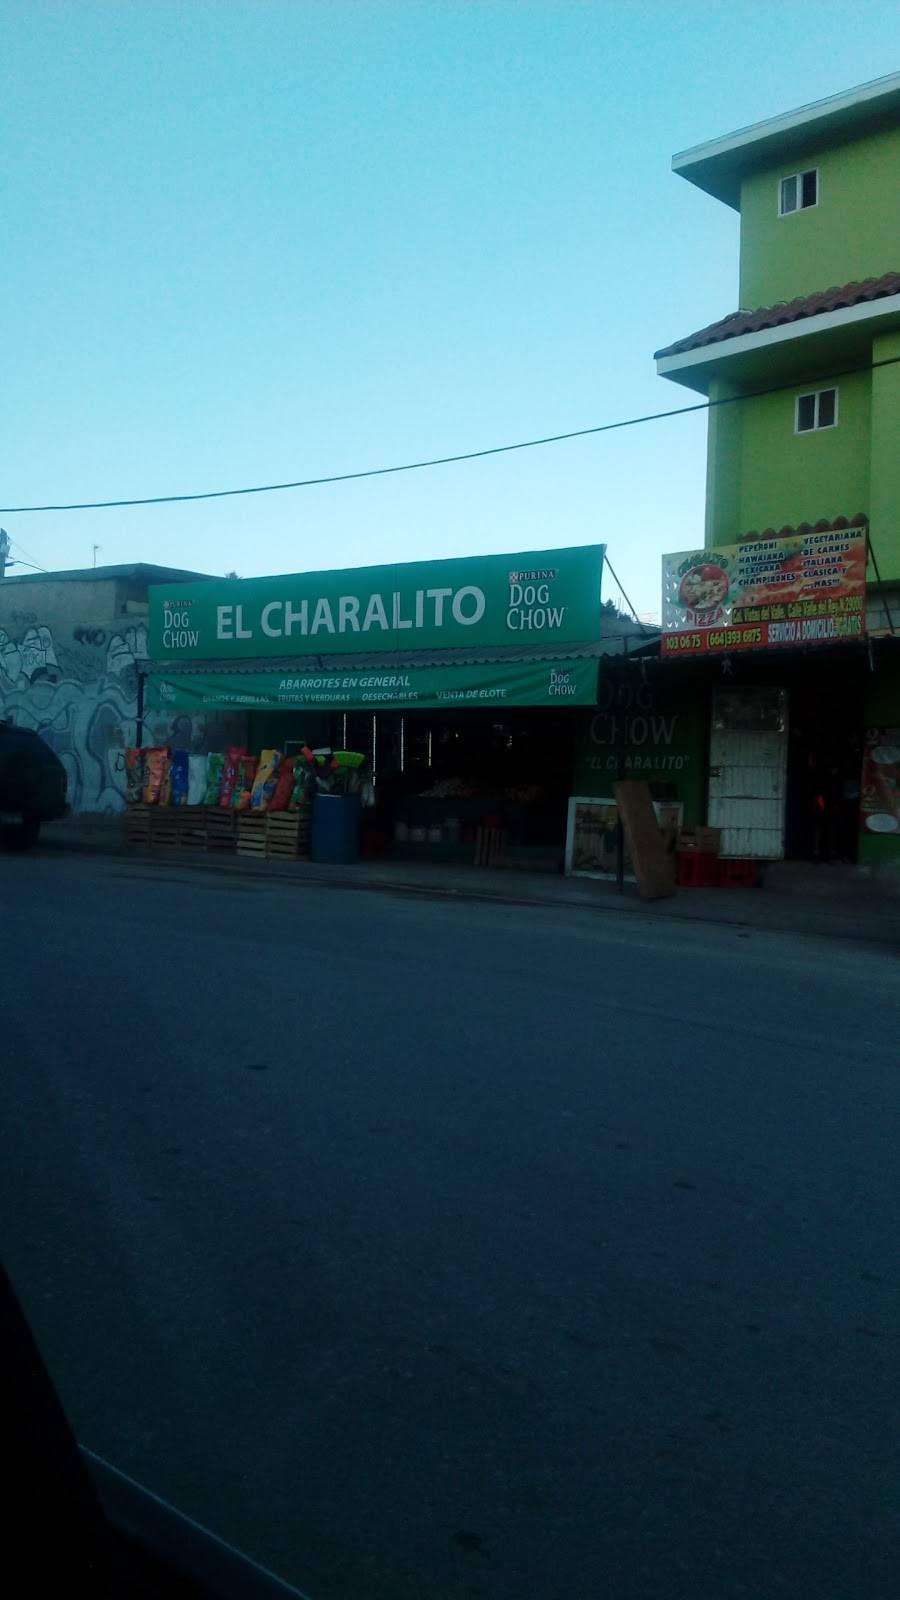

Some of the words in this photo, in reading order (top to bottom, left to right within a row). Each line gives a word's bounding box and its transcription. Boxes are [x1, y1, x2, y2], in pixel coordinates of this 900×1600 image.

[804, 530, 862, 545] VEGETARIANA
[803, 547, 814, 556] DE
[817, 543, 850, 555] CARNES
[739, 552, 784, 564] HAWAIANA
[518, 569, 556, 581] PURINA
[739, 563, 781, 575] MEXICANA
[509, 583, 549, 608] DOG
[164, 609, 189, 629] DOG
[216, 604, 253, 640] EL
[261, 585, 486, 639] CHARALITO
[506, 606, 564, 631] CHOW
[768, 622, 796, 643] SERVICIO
[802, 618, 834, 640] DOMICILIO
[163, 630, 199, 649] CHOW
[278, 677, 341, 690] ABARROTES
[341, 677, 358, 688] EN
[359, 675, 411, 687] GENERAL
[550, 672, 570, 685] DOG
[361, 692, 418, 702] DESECHABLES
[436, 689, 464, 699] VENTA
[465, 690, 478, 699] DE
[479, 688, 507, 698] ELOTE
[548, 684, 577, 696] CHOW
[311, 693, 351, 703] VERDURAS
[589, 713, 679, 746] CHOW
